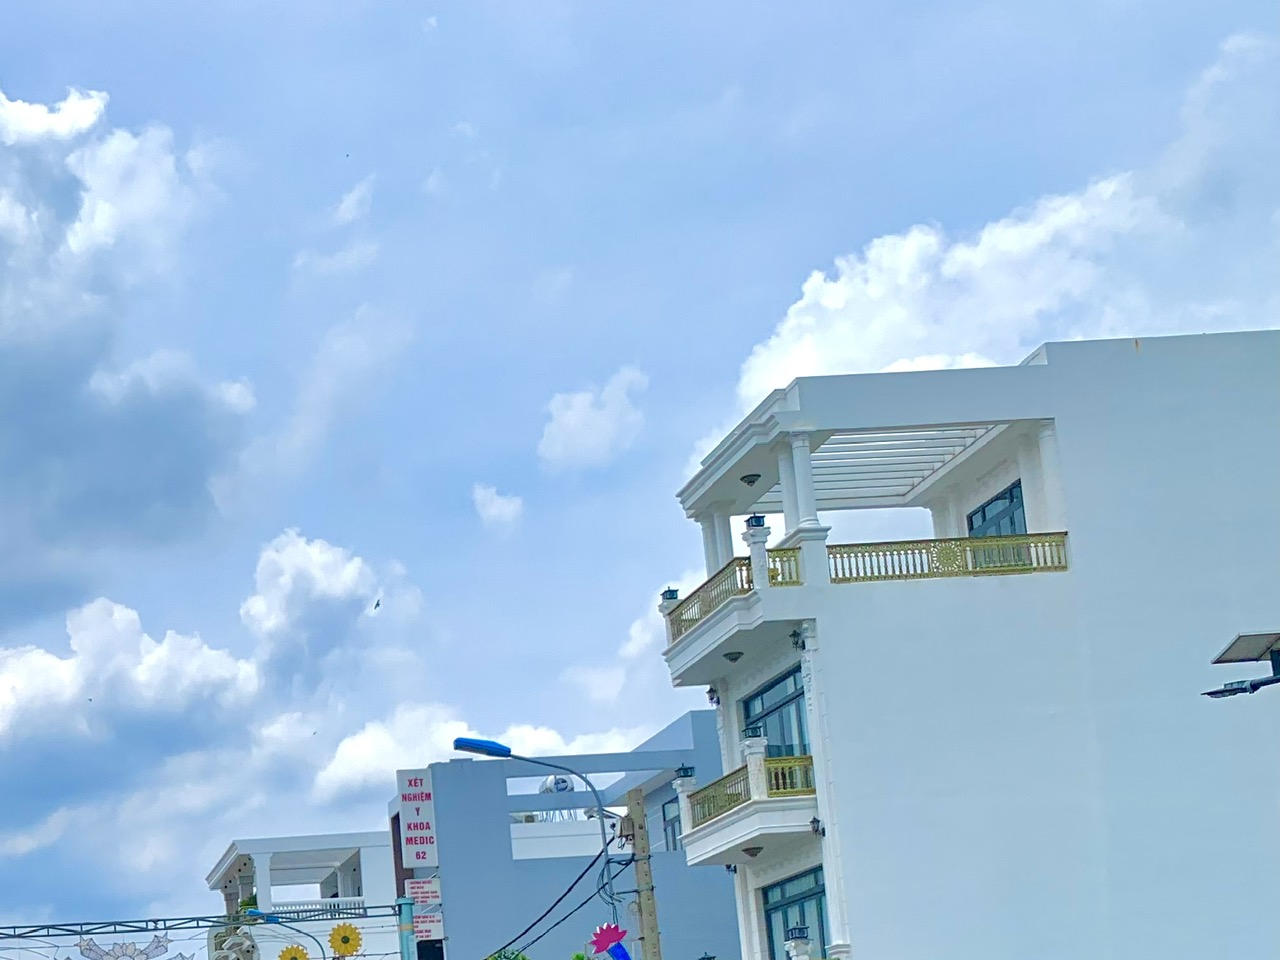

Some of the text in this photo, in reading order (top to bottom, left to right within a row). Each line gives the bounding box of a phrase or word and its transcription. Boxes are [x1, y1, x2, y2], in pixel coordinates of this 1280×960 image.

[407, 777, 424, 788] XÉT
[401, 792, 432, 803] NGHIỆM
[415, 807, 421, 816] Y
[406, 821, 431, 831] KHOA
[405, 836, 435, 846] MEDIC
[415, 851, 427, 860] 62
